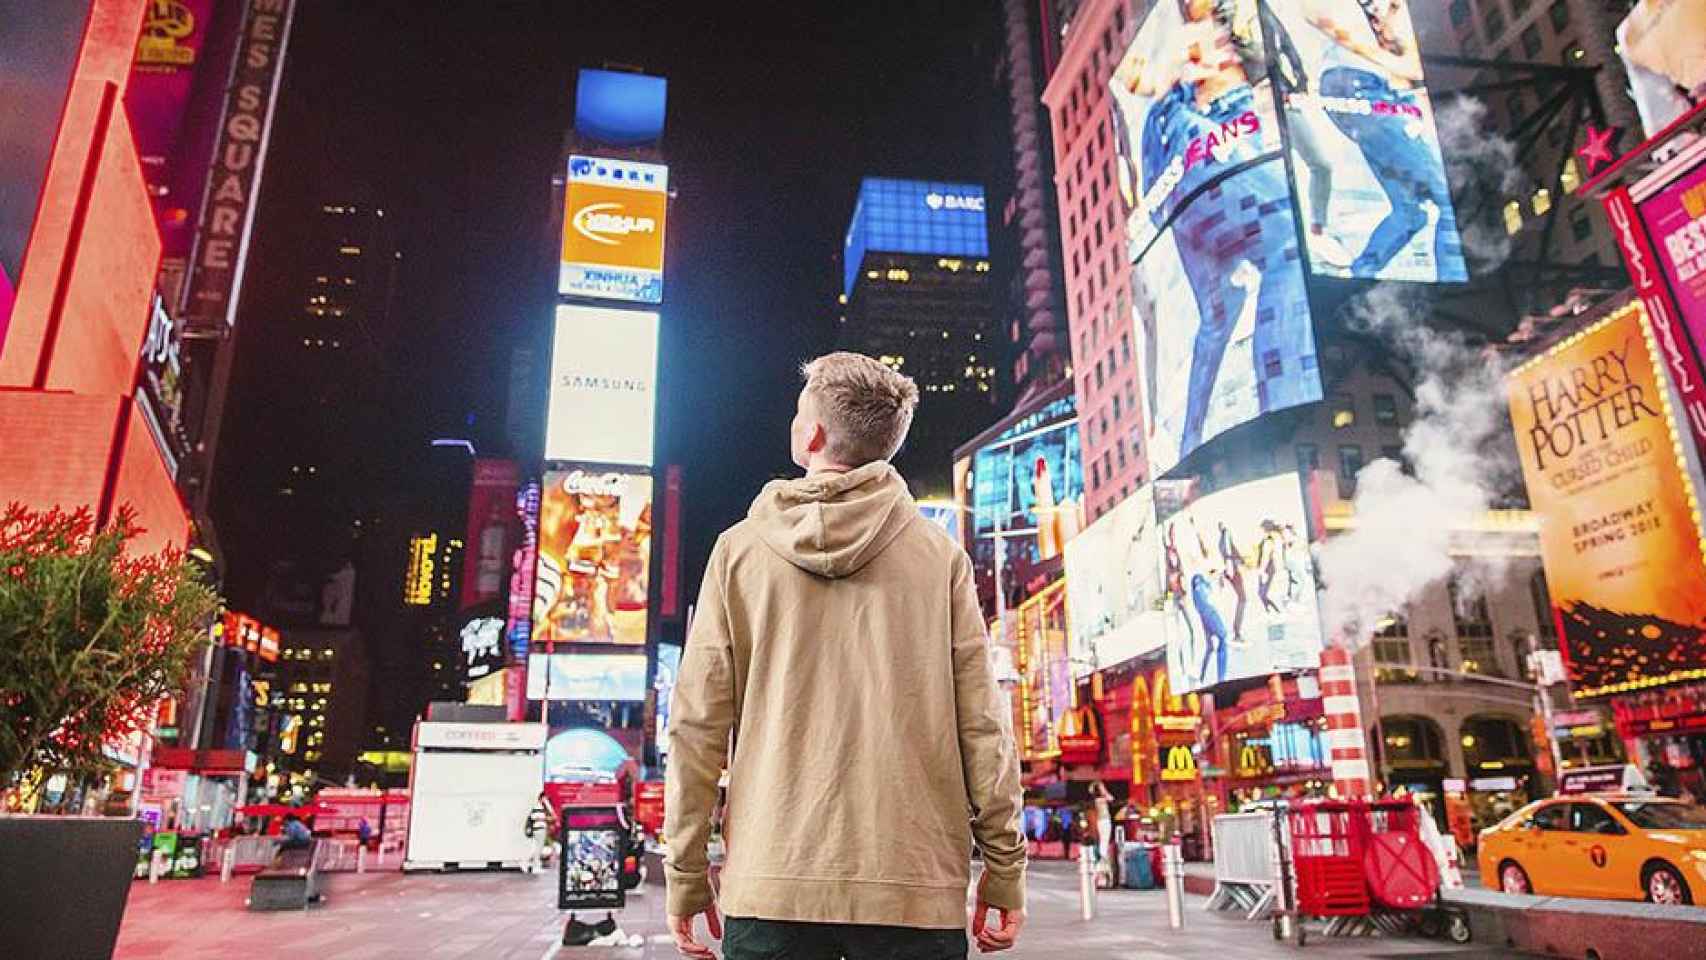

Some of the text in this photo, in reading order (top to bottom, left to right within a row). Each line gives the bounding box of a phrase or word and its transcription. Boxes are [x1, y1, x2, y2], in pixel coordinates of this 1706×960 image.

[203, 85, 262, 268] SQUARE
[561, 374, 646, 392] SAMSUNG
[1529, 339, 1635, 426] HARRY
[1530, 384, 1659, 471] POTTER
[1573, 499, 1656, 538] BROADWAY
[1573, 528, 1626, 554] SPRING
